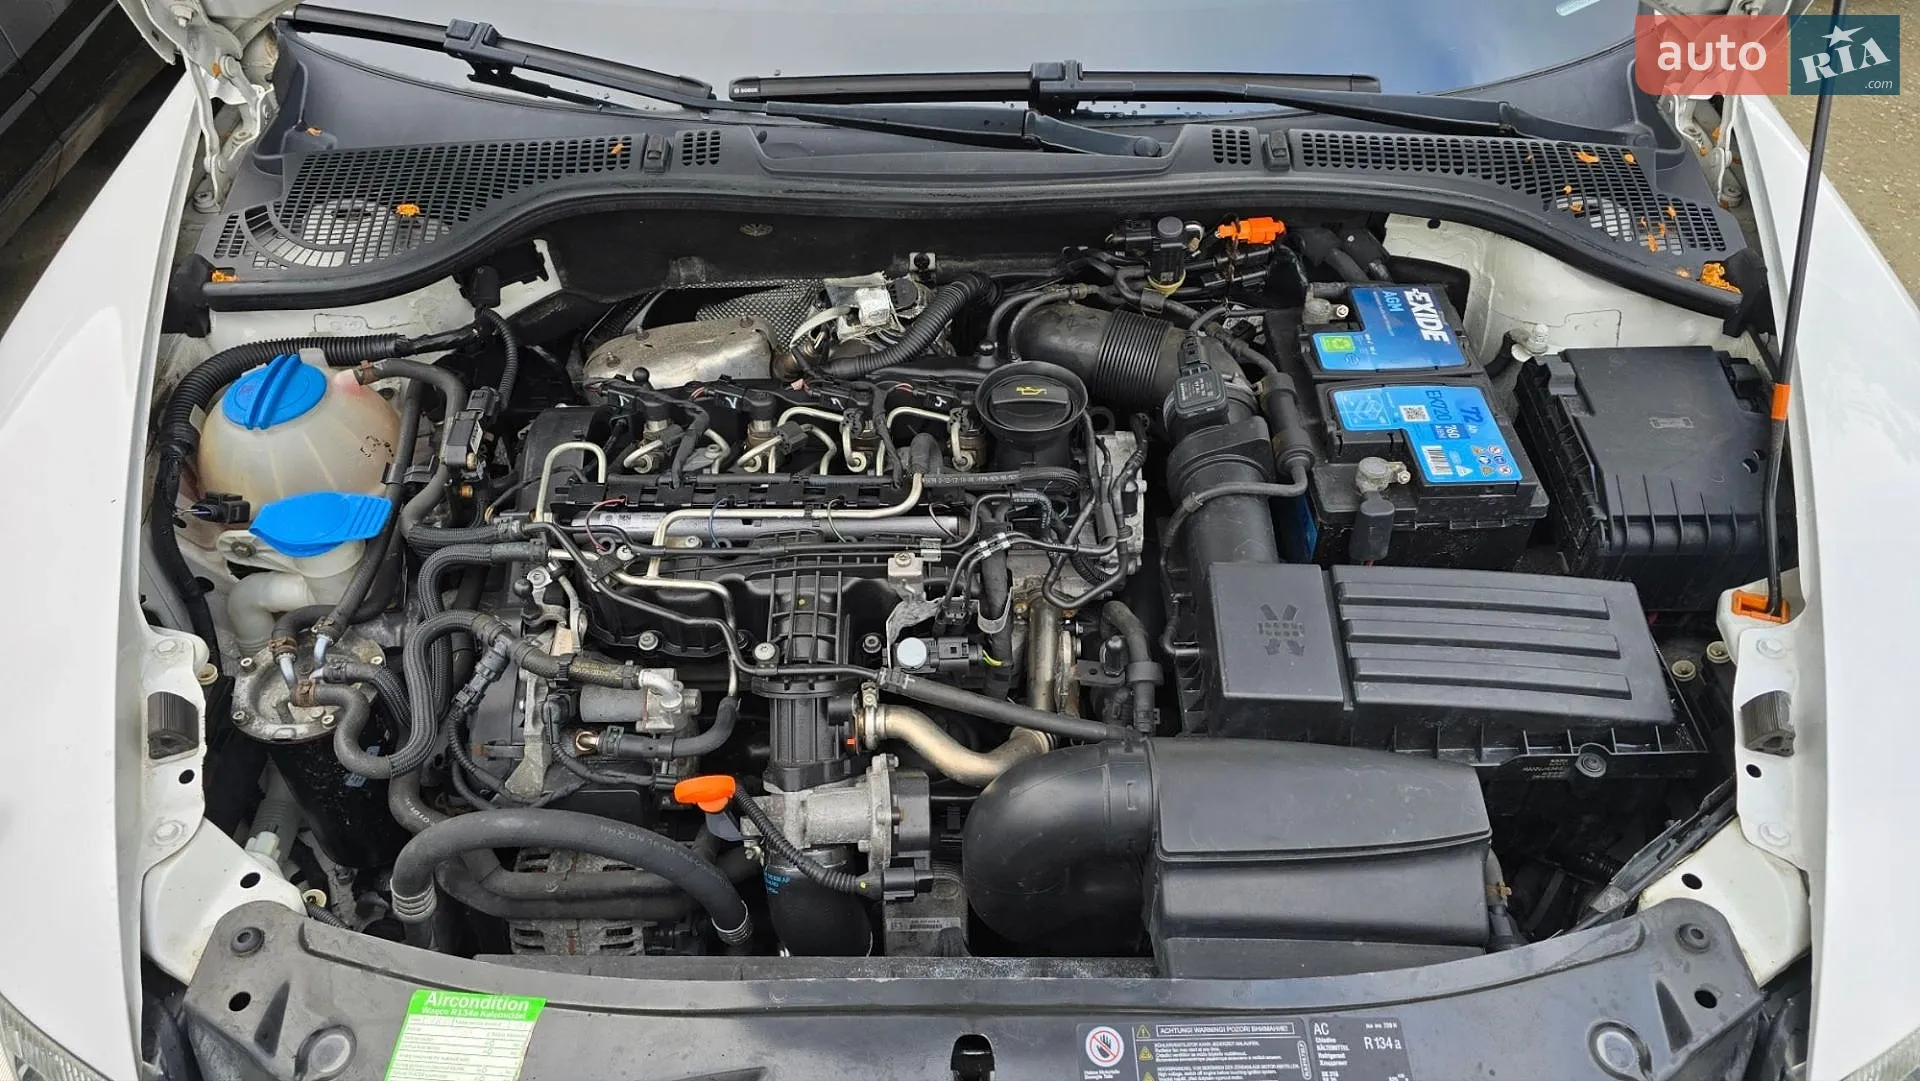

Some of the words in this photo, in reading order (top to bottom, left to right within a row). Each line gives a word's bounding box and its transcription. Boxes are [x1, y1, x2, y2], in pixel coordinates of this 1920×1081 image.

[1382, 290, 1405, 312] AGM
[1403, 288, 1450, 344] EXIDE
[1425, 389, 1453, 421] EK720
[1460, 406, 1484, 423] 72
[425, 991, 529, 1012] Aircondition
[1160, 1026, 1193, 1035] ACHTUNG!
[1194, 1025, 1225, 1034] WARNING!
[1314, 1022, 1330, 1036] AC
